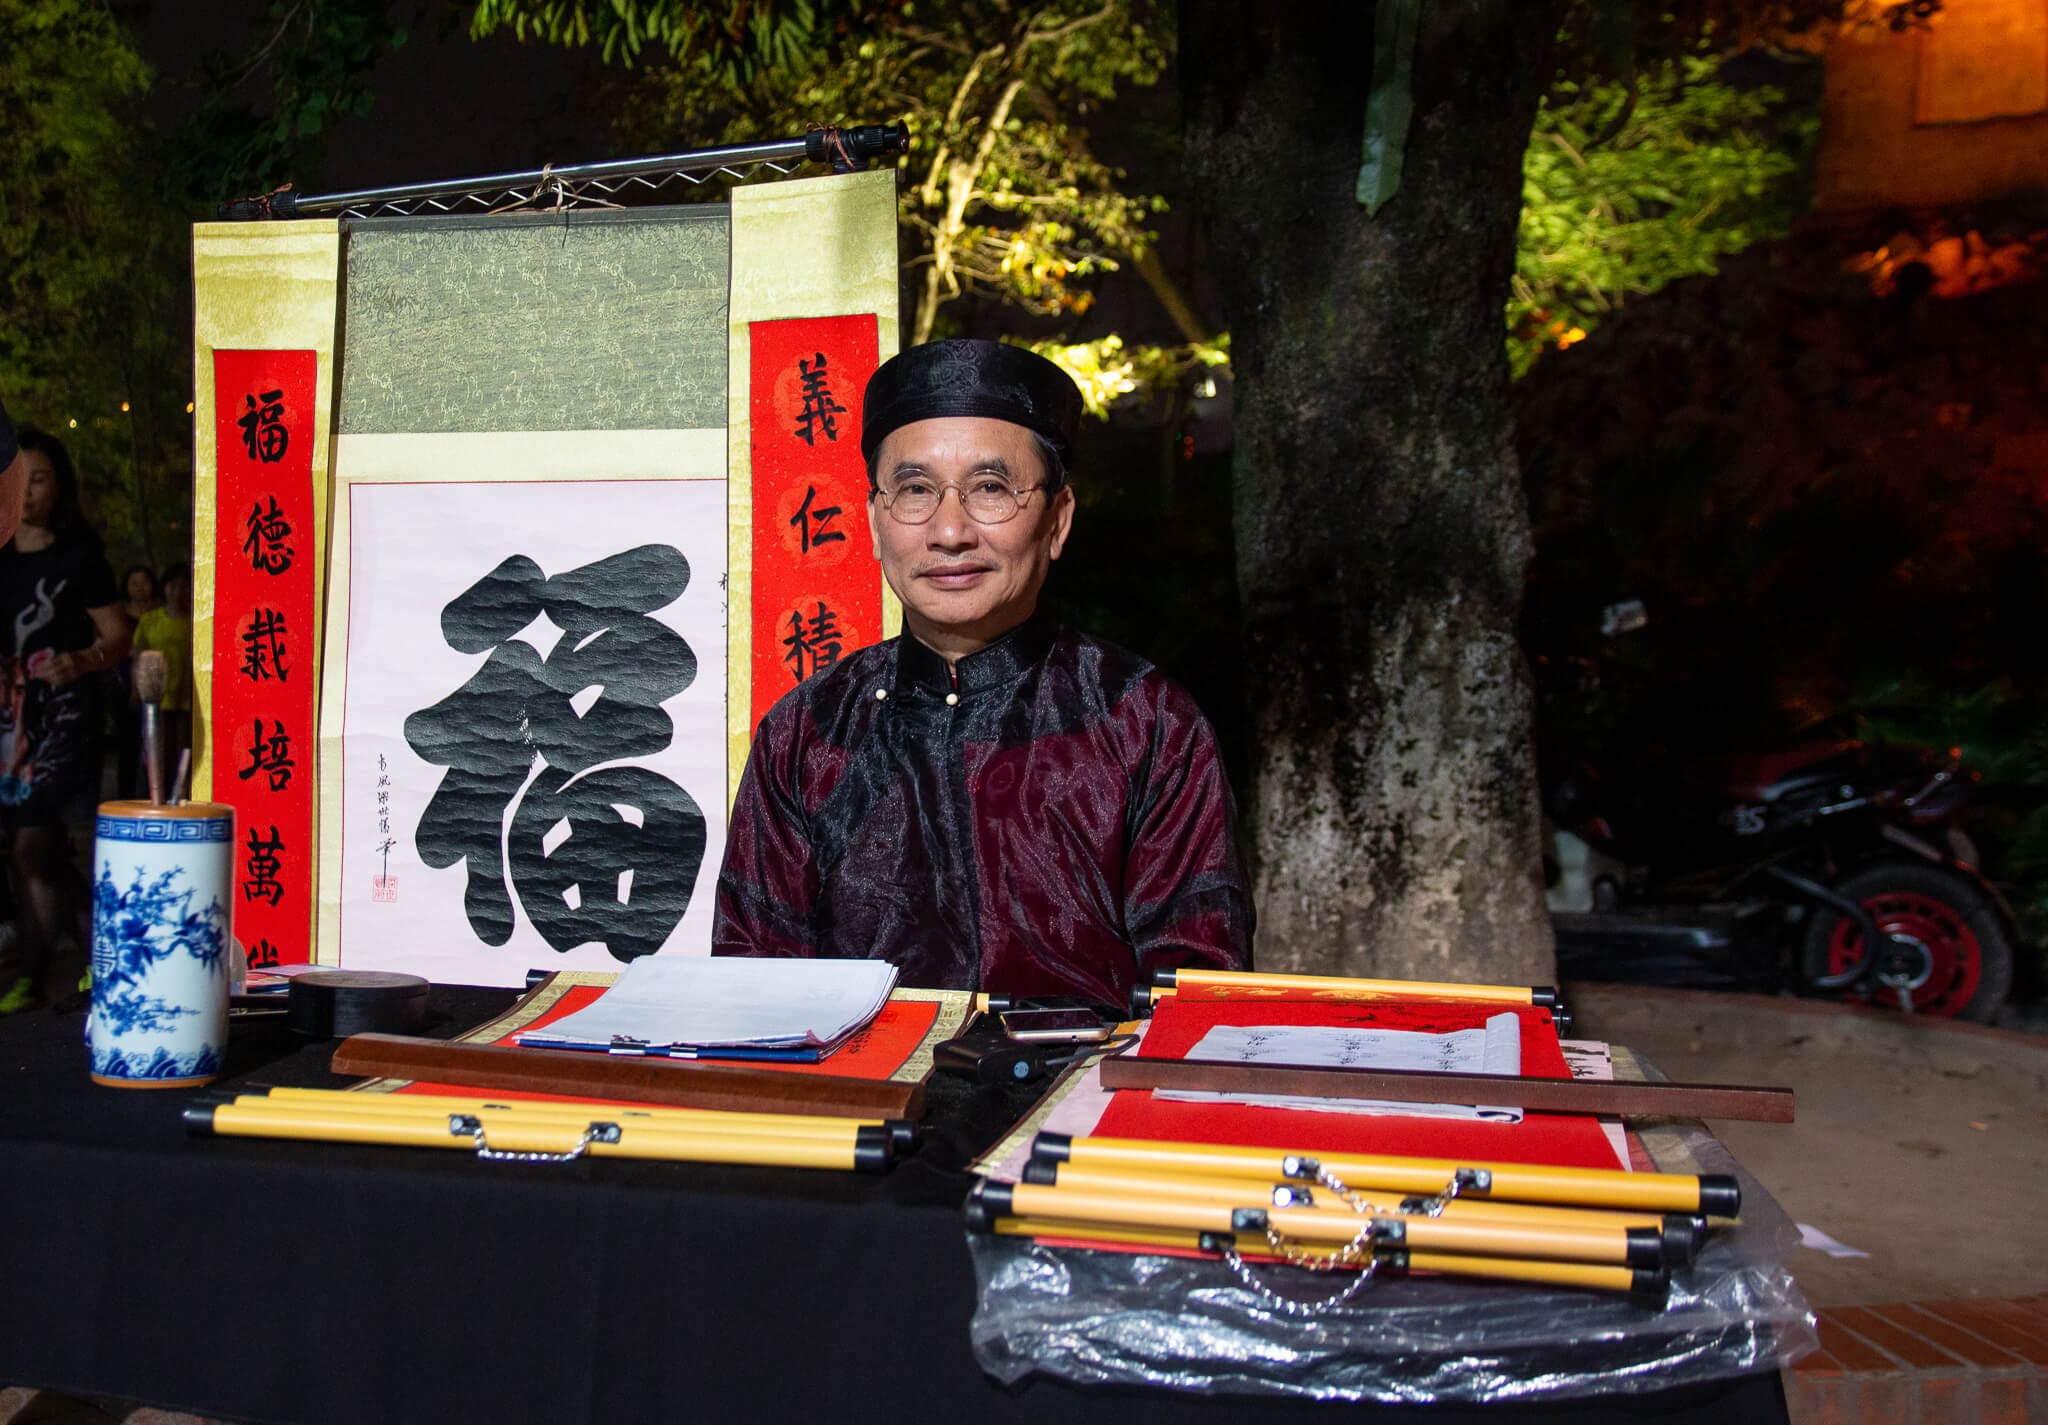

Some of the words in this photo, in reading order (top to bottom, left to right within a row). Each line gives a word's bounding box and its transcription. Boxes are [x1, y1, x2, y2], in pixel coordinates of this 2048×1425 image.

[781, 351, 848, 685] 義仁積
[403, 543, 707, 964] 福
